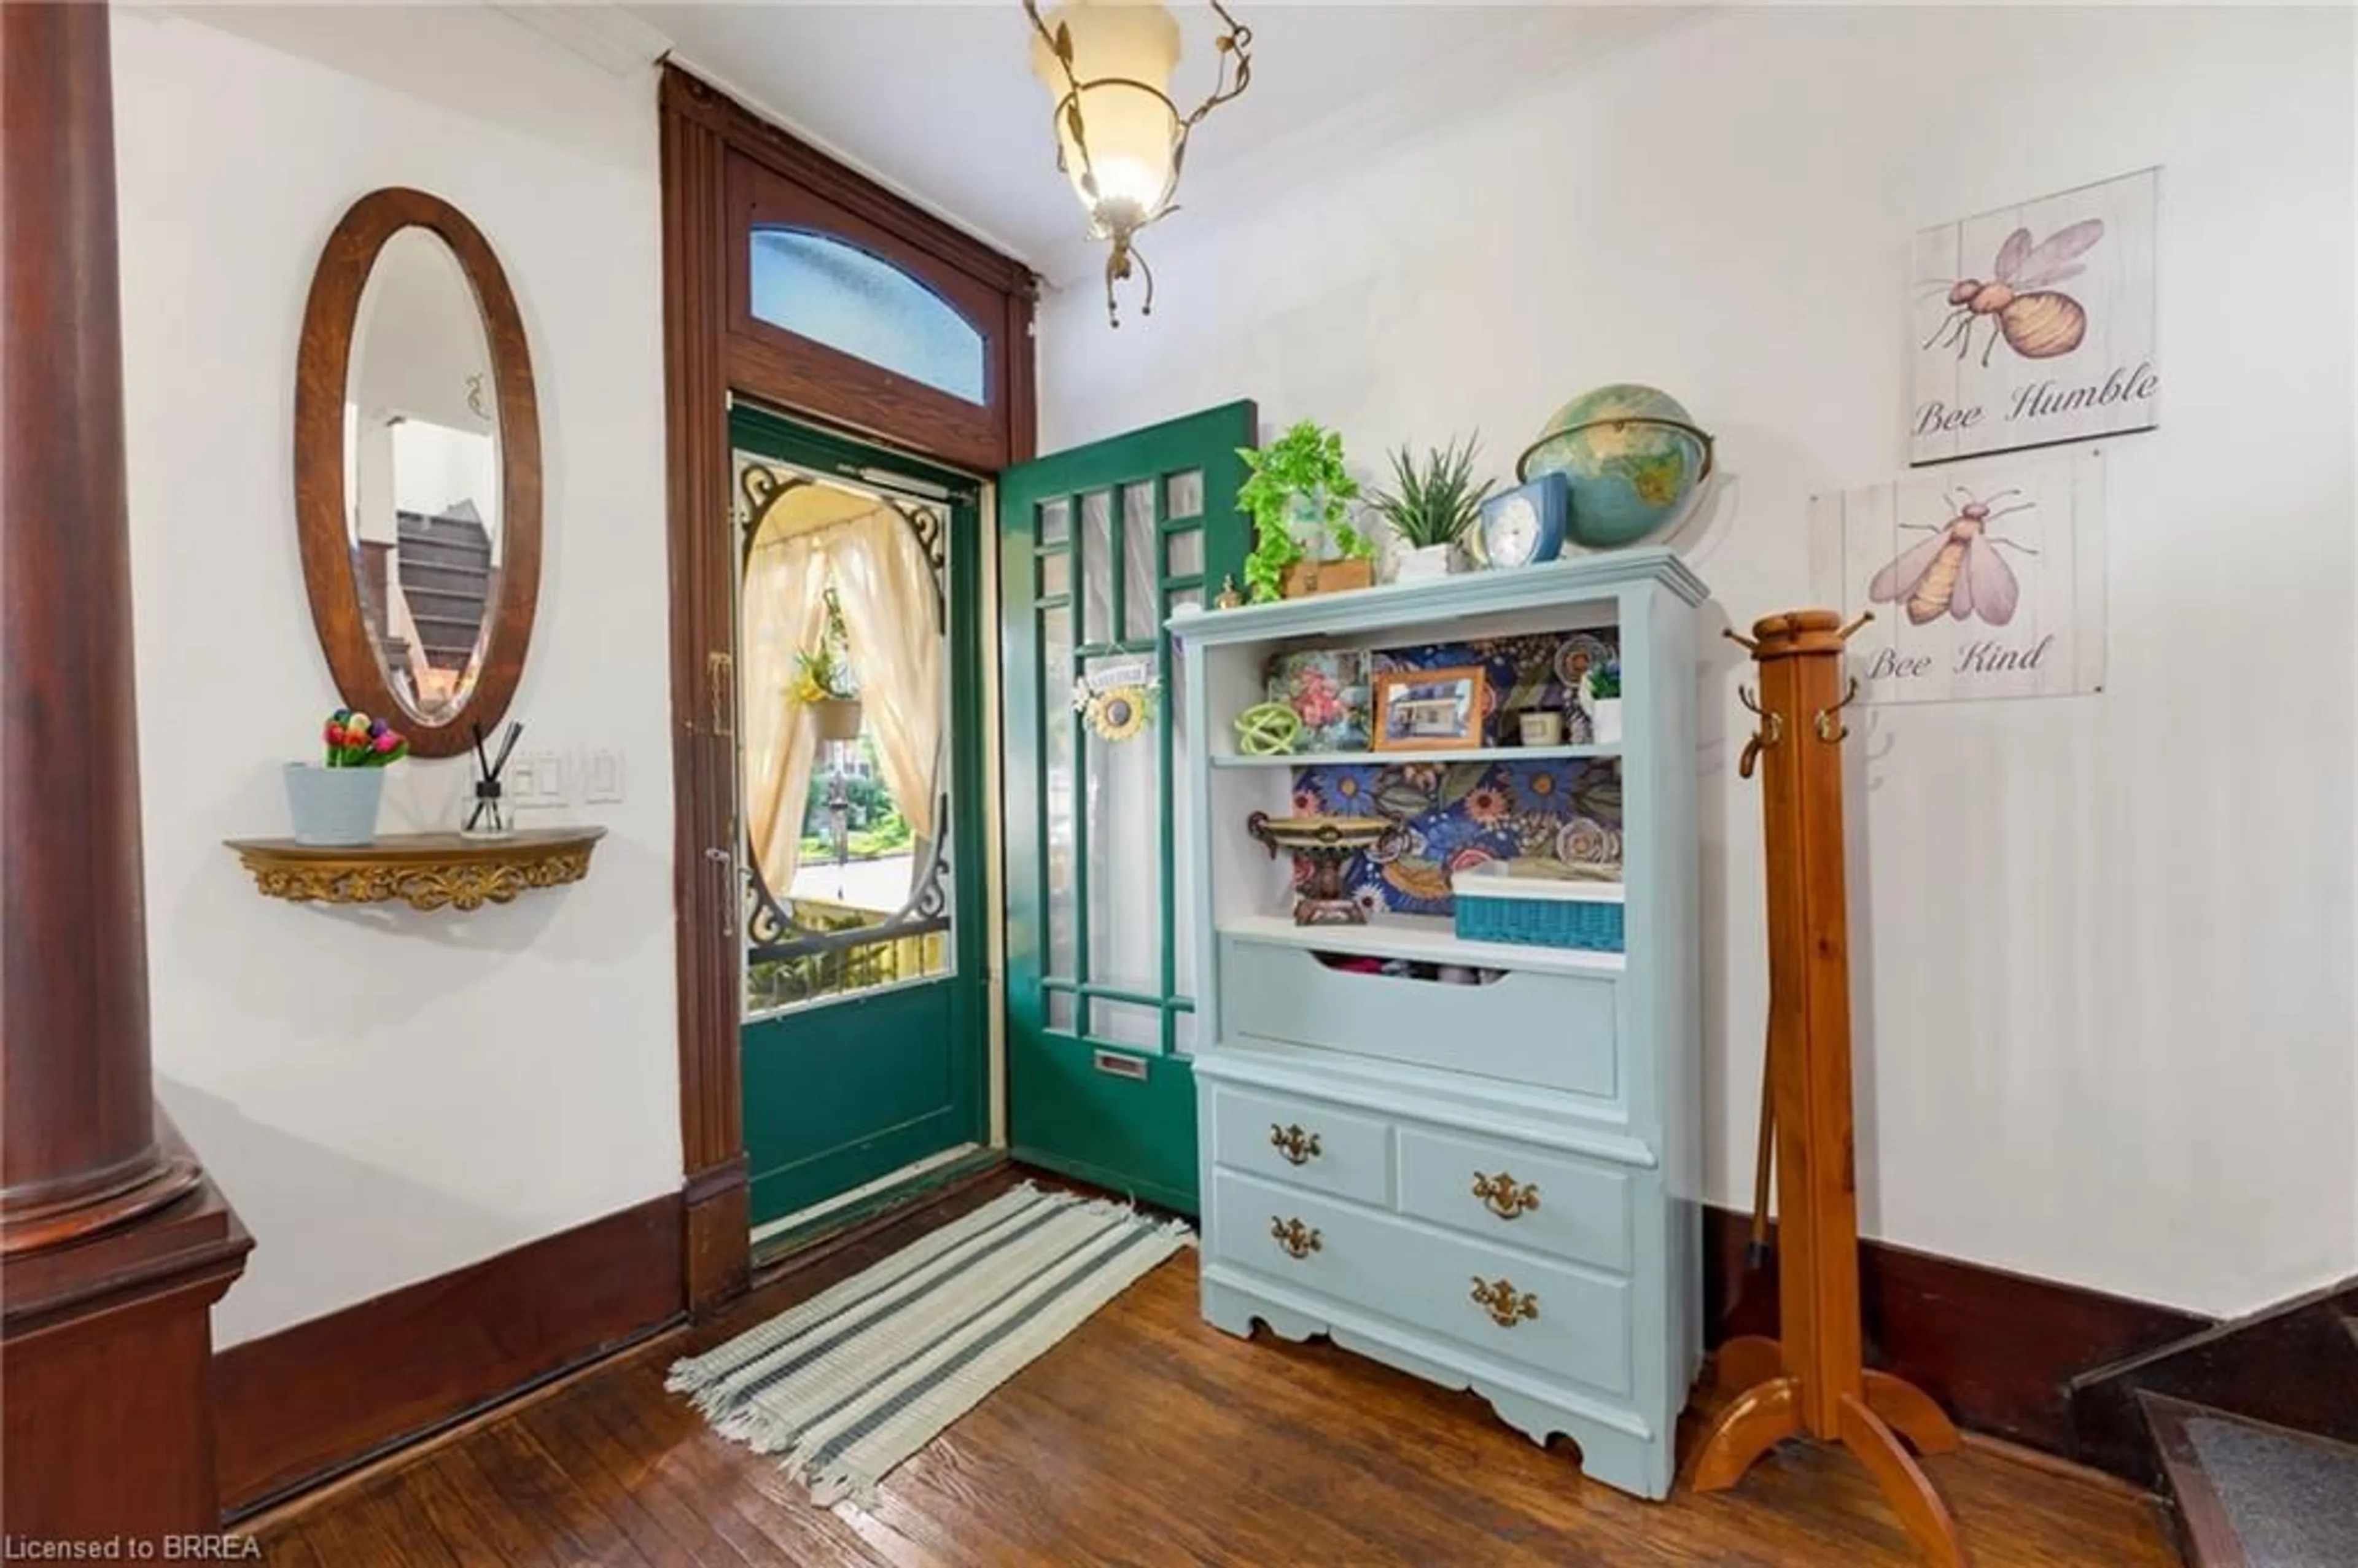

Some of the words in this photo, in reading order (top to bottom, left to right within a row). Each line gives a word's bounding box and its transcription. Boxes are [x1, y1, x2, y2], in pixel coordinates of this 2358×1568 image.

[1914, 400, 1985, 435] Bee
[2004, 361, 2160, 422] Humble
[1869, 646, 1932, 680] Bee
[1953, 633, 2055, 674] Kind
